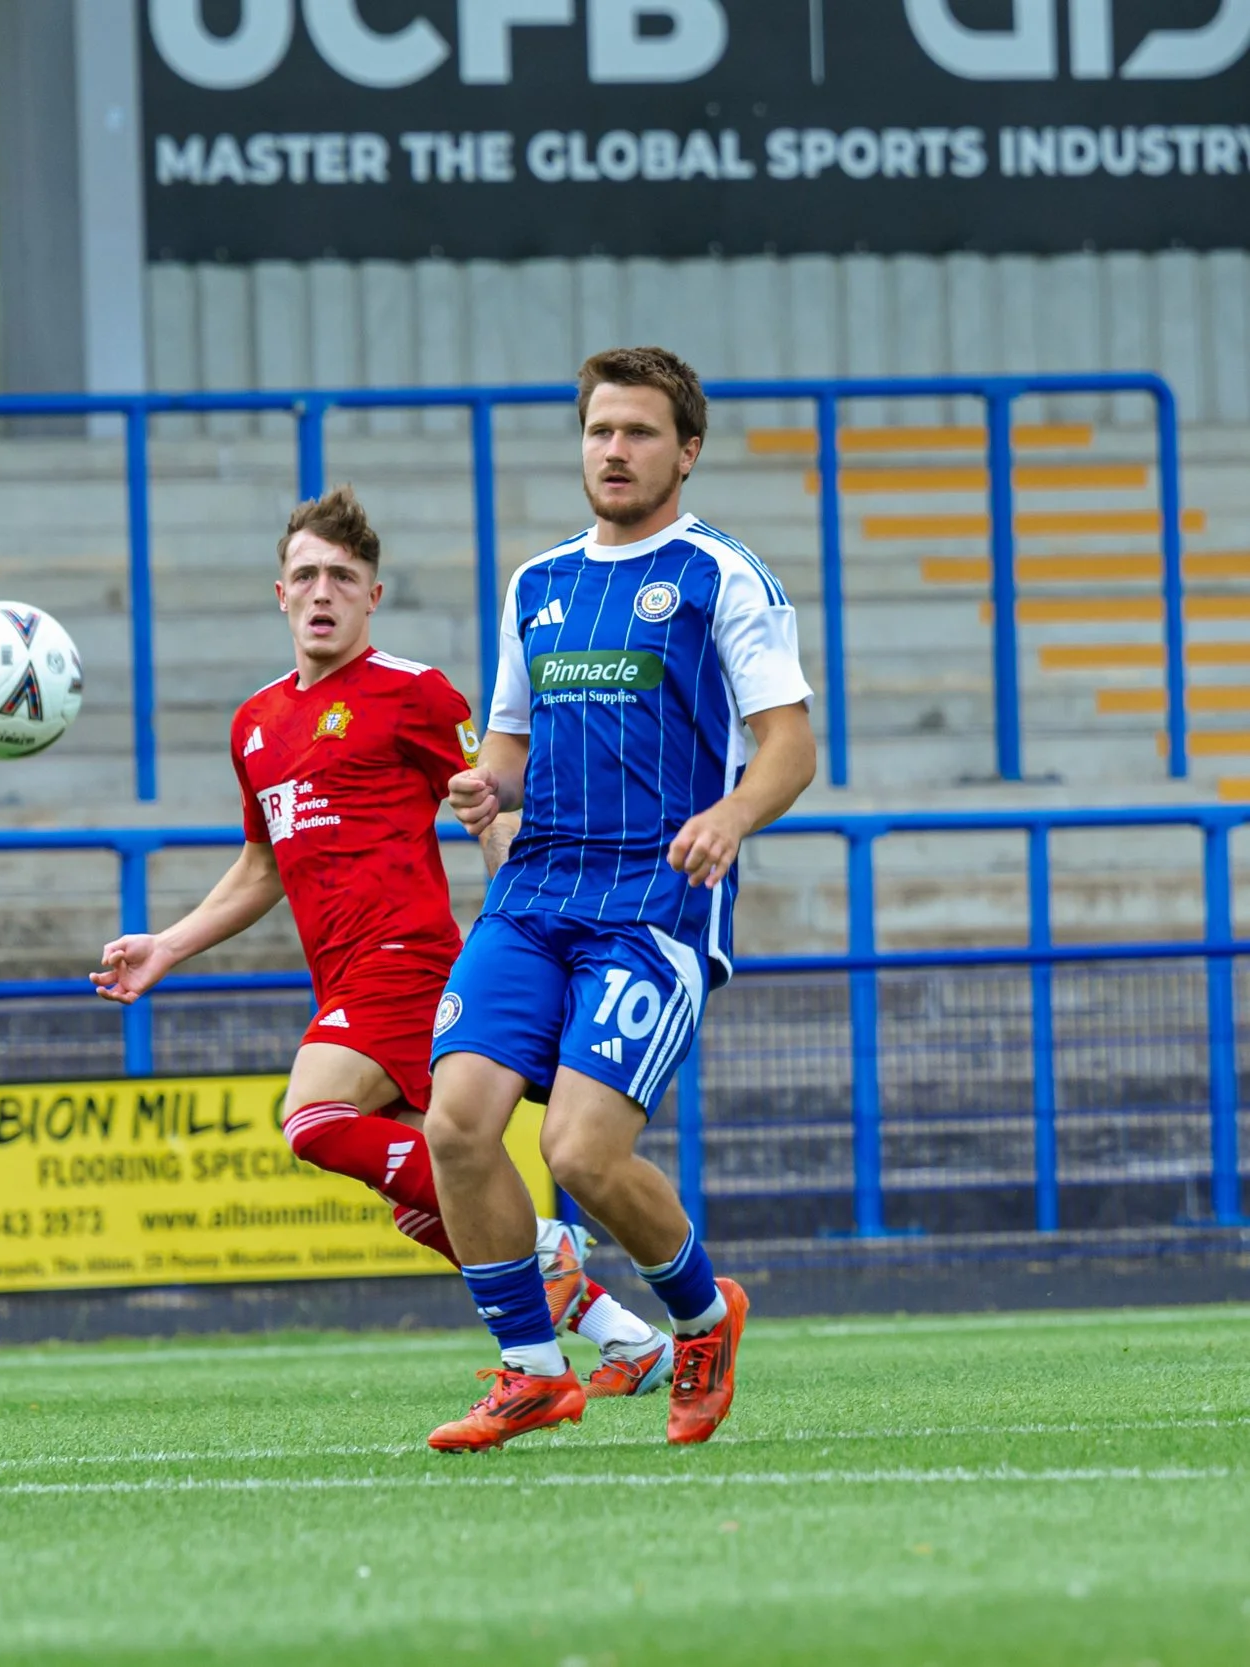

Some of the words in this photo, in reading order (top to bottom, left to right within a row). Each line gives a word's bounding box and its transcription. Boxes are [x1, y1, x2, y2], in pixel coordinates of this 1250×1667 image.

[155, 132, 389, 184] MASTER
[400, 131, 514, 182] THE
[527, 129, 756, 181] GLOBAL
[765, 127, 987, 179] SPORTS
[541, 657, 639, 685] Pinnacle
[542, 691, 586, 705] Electrical
[588, 690, 637, 705] Supplies
[593, 968, 662, 1041] 10
[134, 1086, 256, 1142] MILL
[38, 1153, 182, 1190] FLOORING
